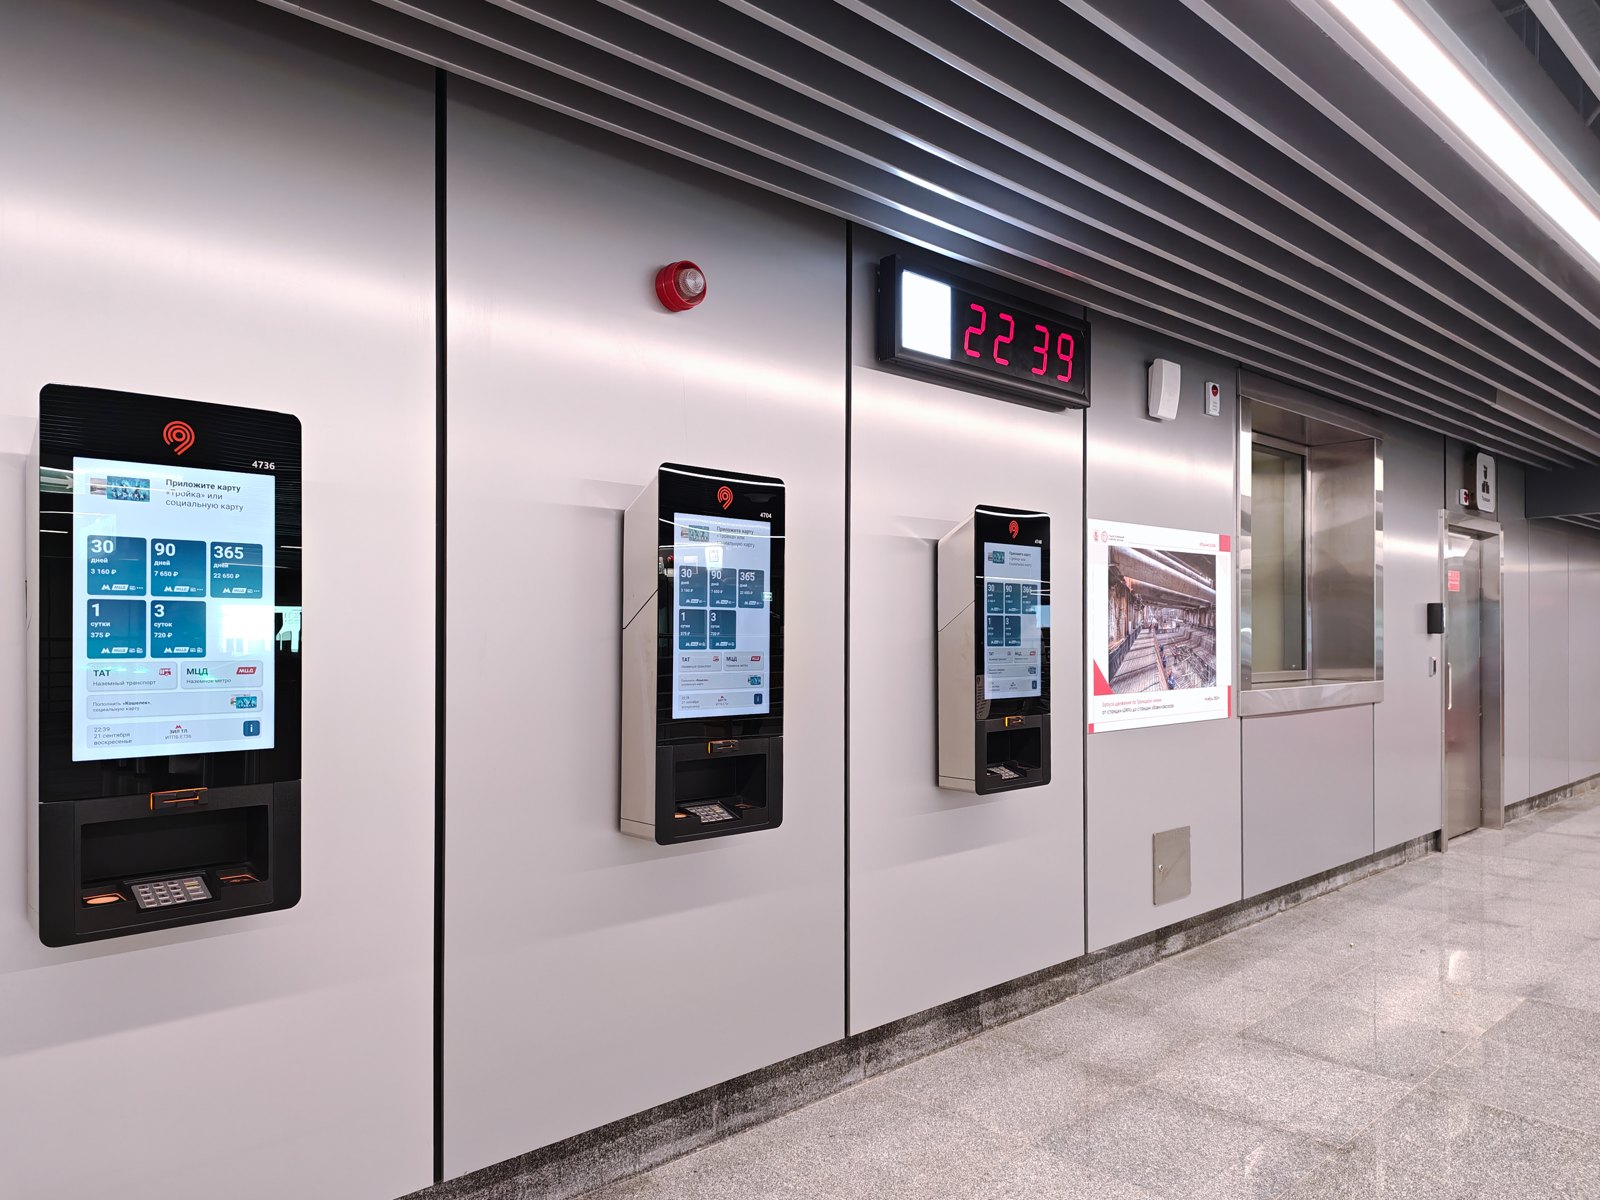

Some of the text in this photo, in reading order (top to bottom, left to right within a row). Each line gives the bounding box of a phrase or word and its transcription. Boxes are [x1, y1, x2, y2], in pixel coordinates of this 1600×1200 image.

[964, 304, 1074, 382] 22 39
[252, 461, 275, 469] 4736
[166, 478, 241, 493] Приложите карту
[166, 500, 243, 512] социальную карту
[91, 539, 114, 554] 30
[154, 543, 175, 556] 90
[214, 546, 244, 559] 365
[681, 569, 692, 578] 30
[711, 570, 721, 579] 90
[740, 572, 755, 581] 365
[92, 603, 100, 616] 1
[154, 604, 165, 617] 3
[681, 612, 685, 621] 1
[711, 613, 716, 621] 3
